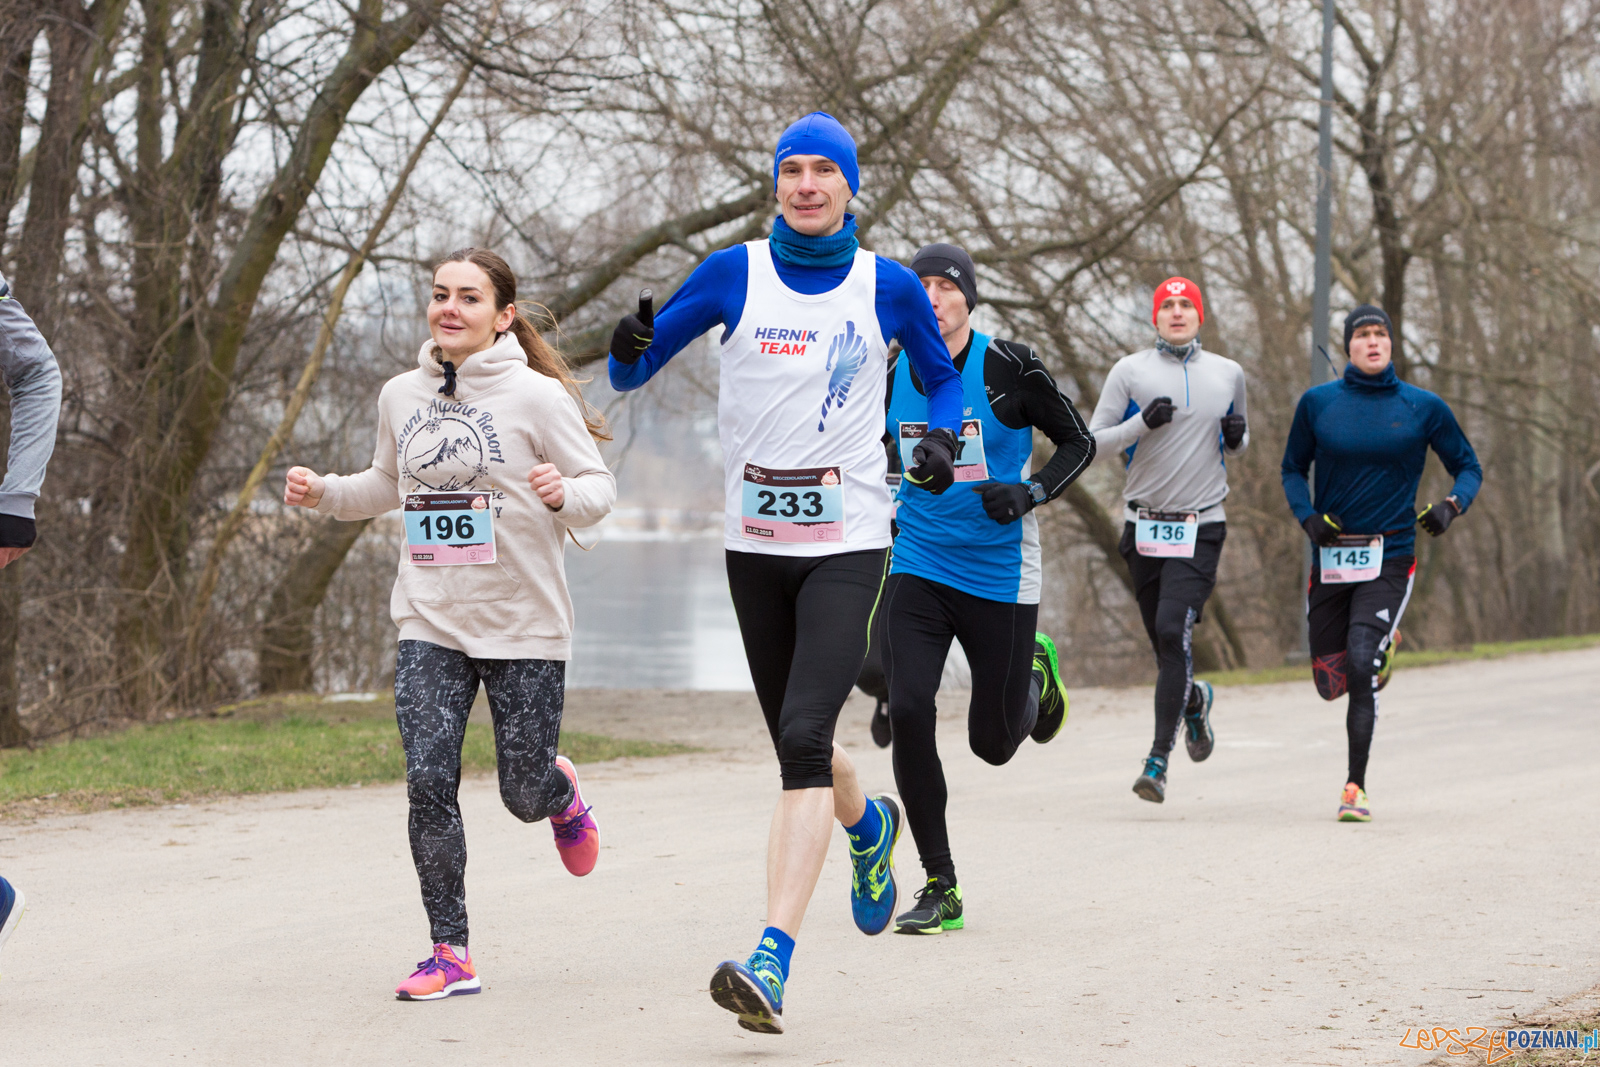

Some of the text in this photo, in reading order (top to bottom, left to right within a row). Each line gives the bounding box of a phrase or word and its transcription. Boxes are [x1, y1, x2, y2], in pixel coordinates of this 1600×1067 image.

[754, 327, 819, 343] HERNIK
[760, 341, 807, 356] TEAM
[426, 398, 478, 418] Alpine
[476, 412, 505, 464] Resort
[757, 490, 823, 518] 233
[419, 515, 475, 540] 196
[1149, 523, 1185, 541] 136
[1332, 550, 1370, 566] 145
